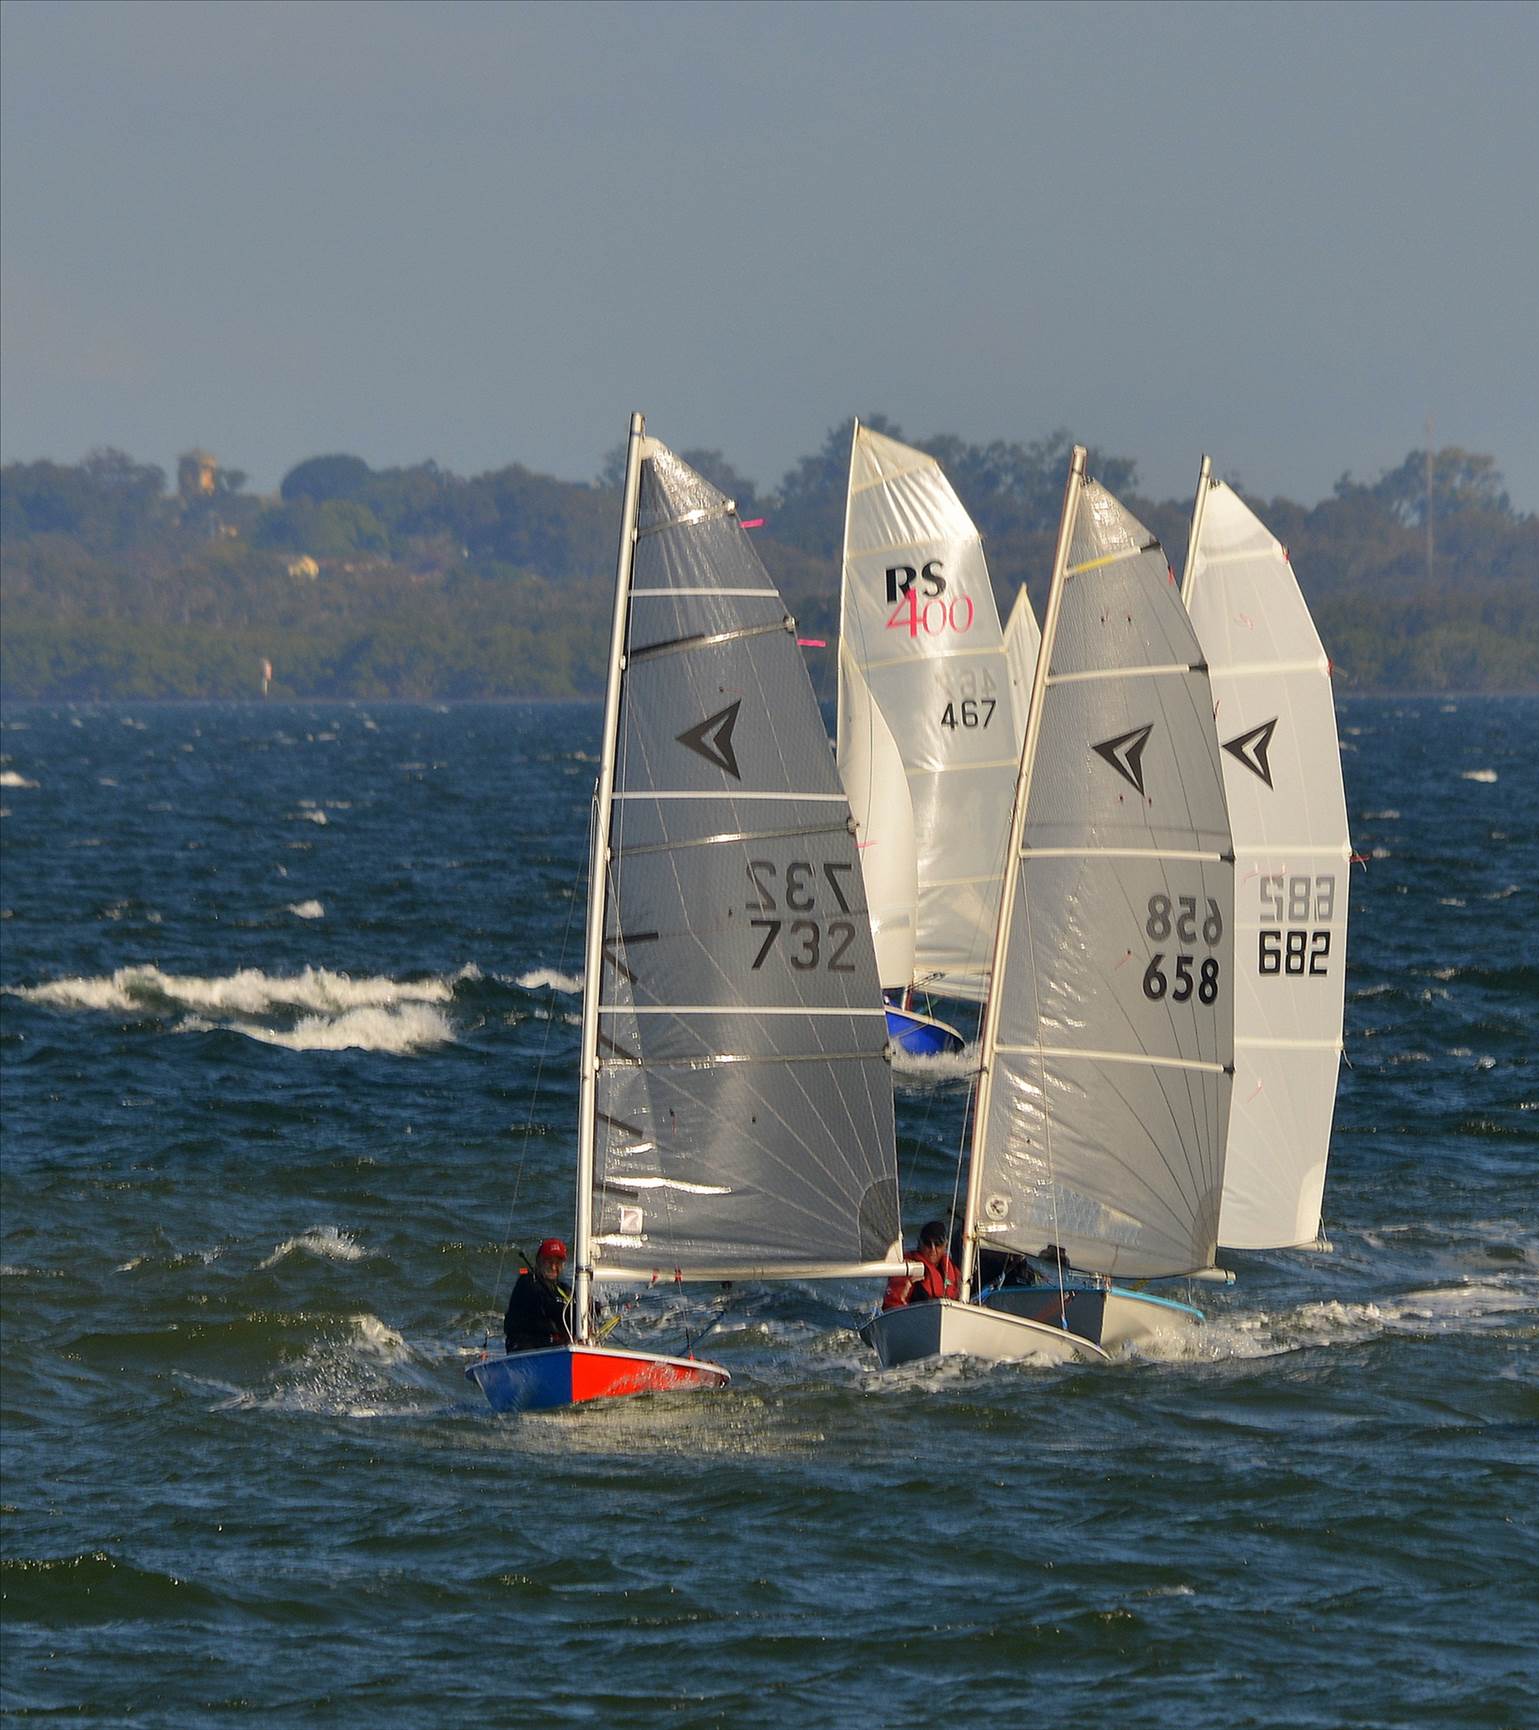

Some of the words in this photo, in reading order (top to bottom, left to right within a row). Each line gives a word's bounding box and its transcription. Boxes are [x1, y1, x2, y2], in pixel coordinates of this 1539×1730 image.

[885, 559, 947, 605] RS
[885, 586, 975, 638] 400
[940, 698, 997, 731] 467
[749, 919, 857, 972] 732
[1257, 930, 1332, 977] 682
[1142, 954, 1220, 1006] 658
